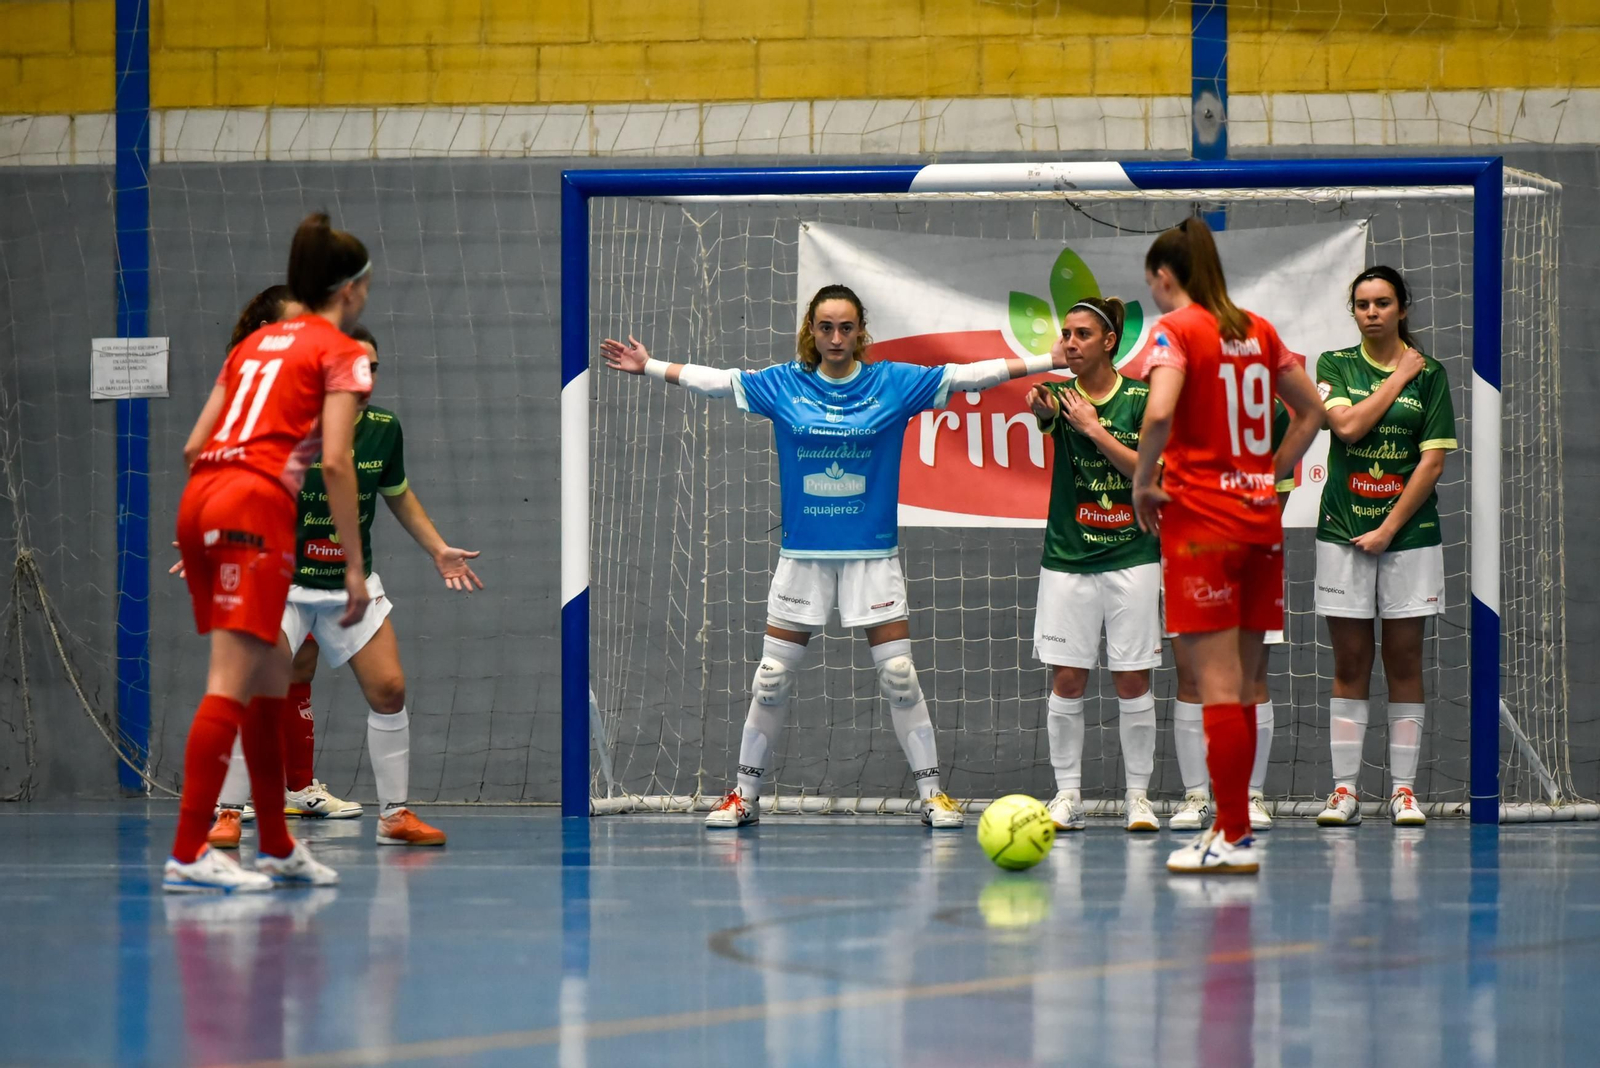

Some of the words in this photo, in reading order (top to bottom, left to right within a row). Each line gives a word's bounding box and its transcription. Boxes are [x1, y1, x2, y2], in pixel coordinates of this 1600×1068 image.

[214, 358, 284, 442] 11
[1218, 363, 1272, 456] 19
[357, 460, 383, 470] NACEX
[806, 479, 864, 491] Primeale
[1352, 477, 1401, 492] Primeale
[803, 503, 859, 517] aquajerez
[1079, 507, 1131, 523] Primeale
[1082, 532, 1132, 543] quajerez
[307, 543, 345, 556] Prime
